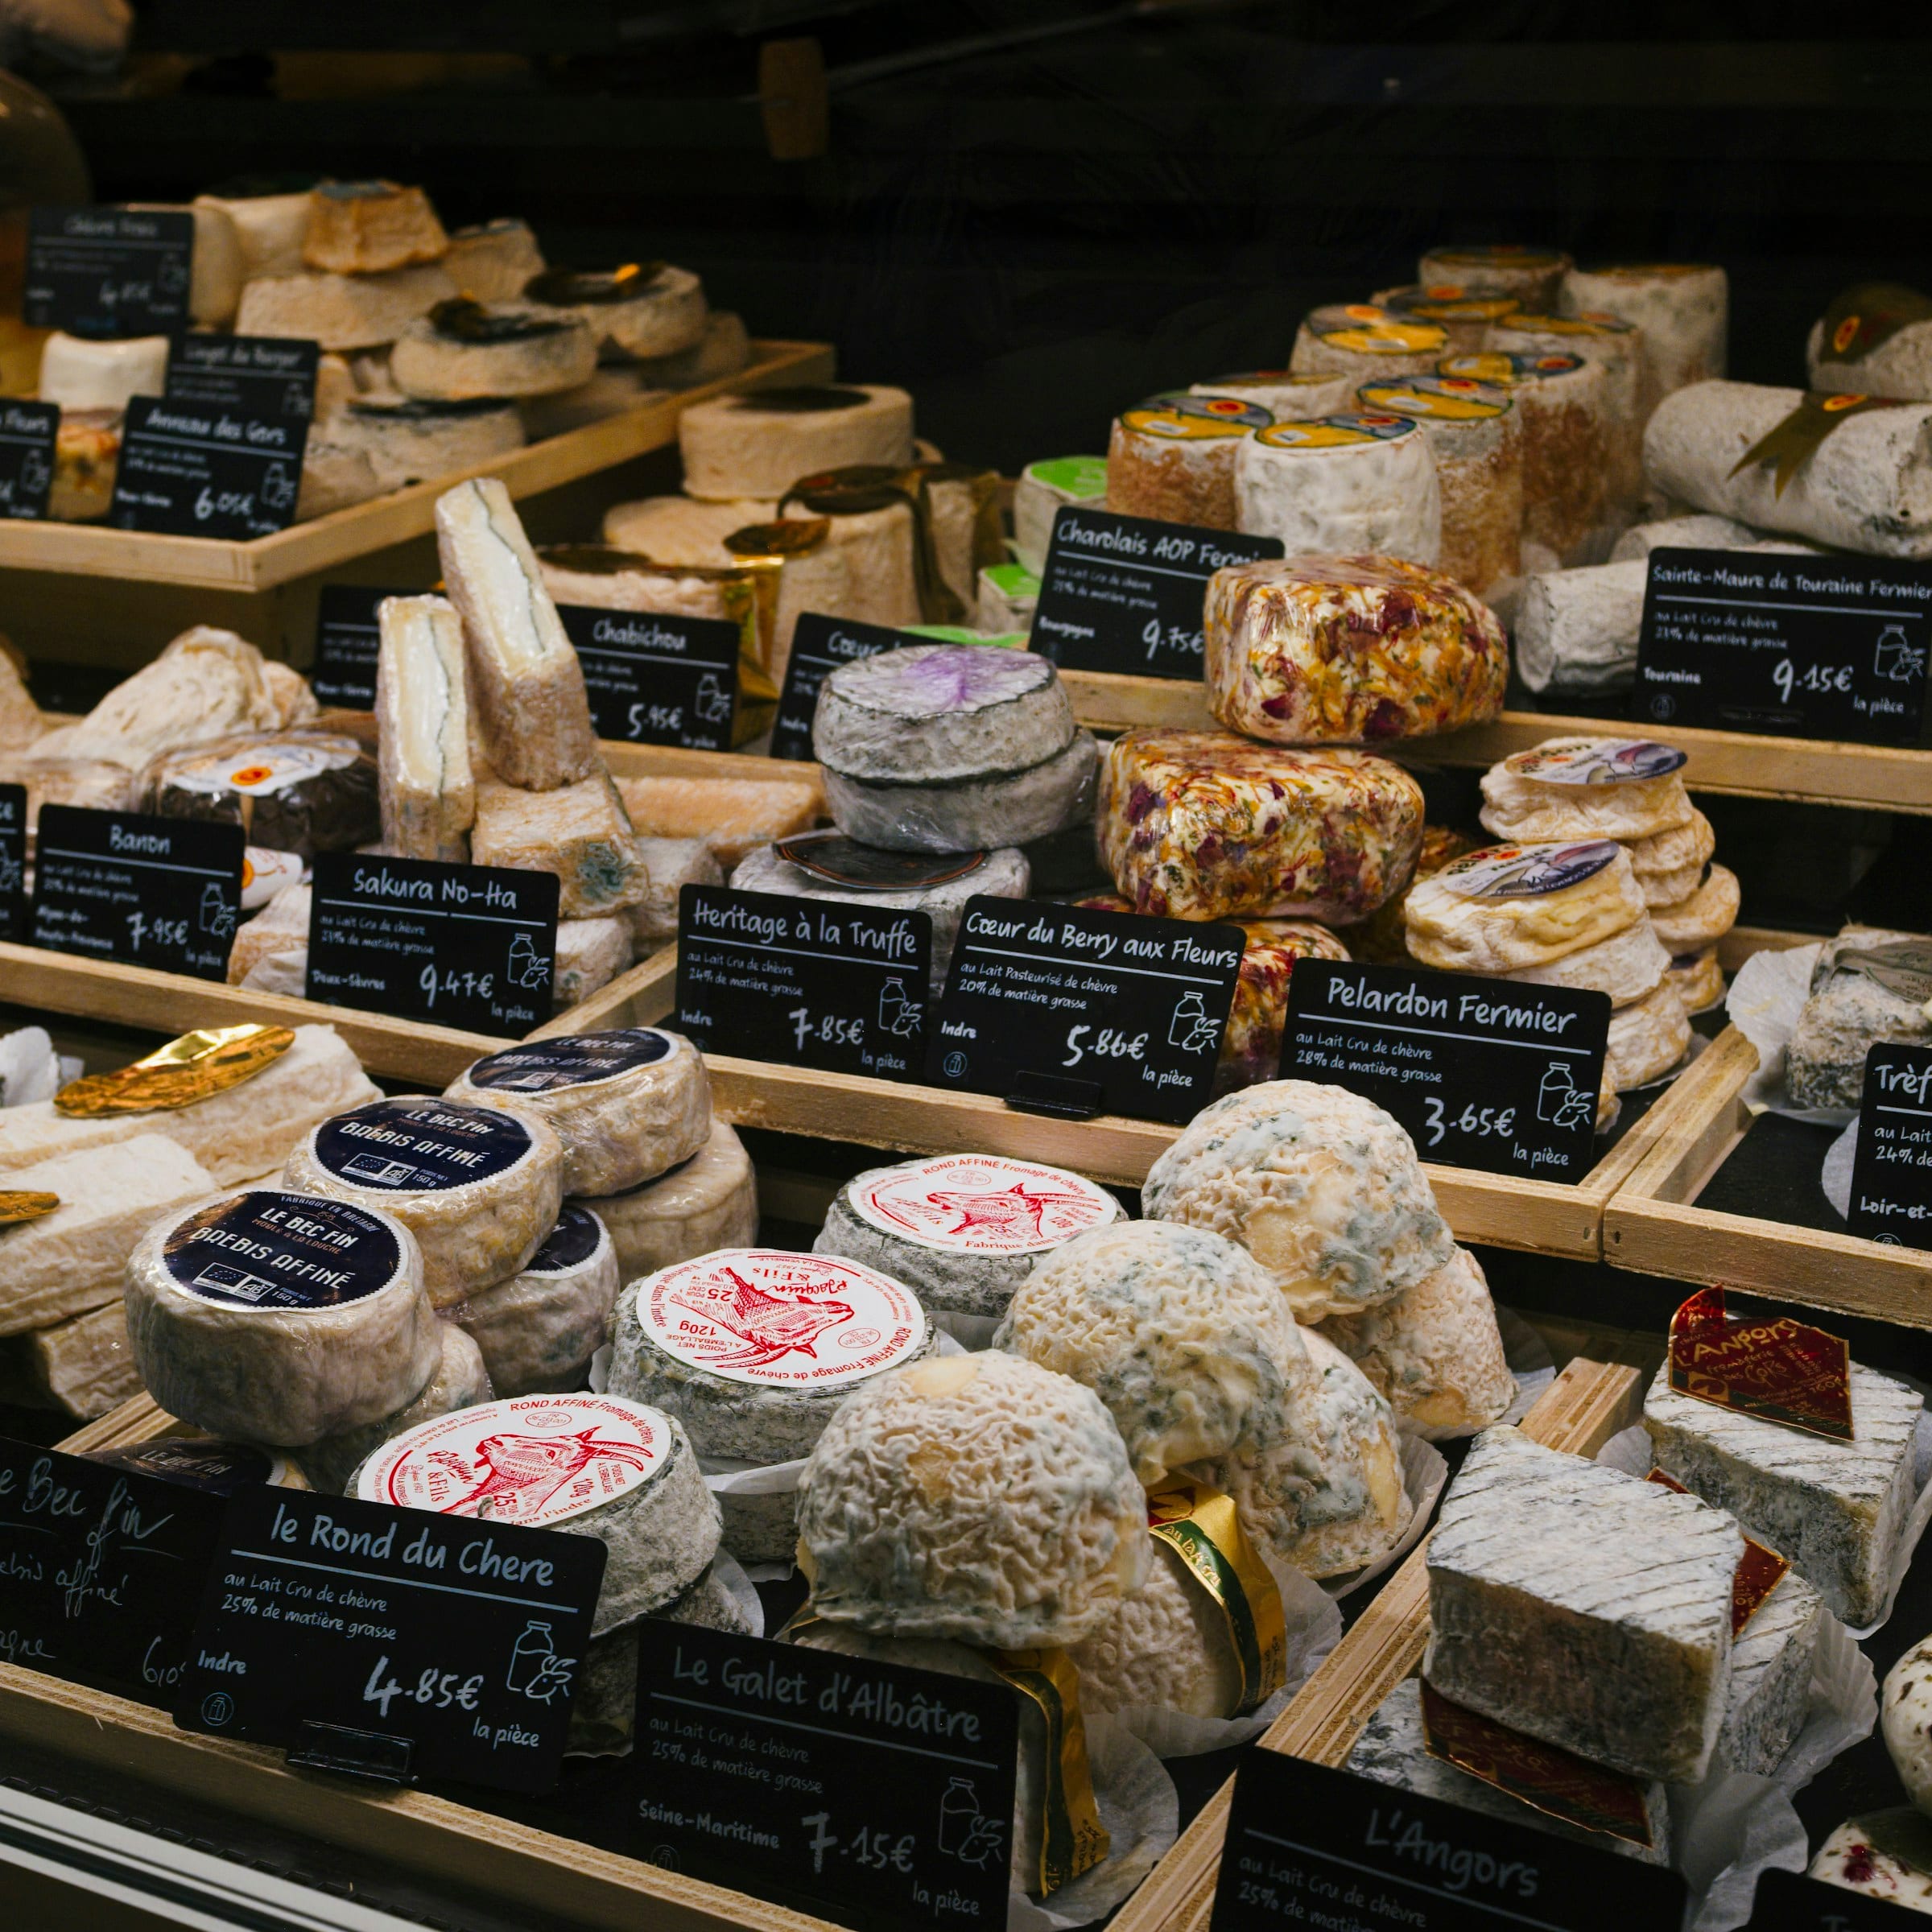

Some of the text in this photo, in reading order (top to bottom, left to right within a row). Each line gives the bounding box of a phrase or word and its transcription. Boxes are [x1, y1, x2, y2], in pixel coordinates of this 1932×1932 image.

[1056, 518, 1260, 568] Charolais AOP Fermi
[1653, 564, 1932, 601] Sainte-Maure de Touraine Fermier
[592, 617, 687, 650] Chabichou
[1644, 666, 1702, 685] Touraine
[1773, 658, 1853, 704] 9.15€
[1853, 695, 1905, 718] la pièce
[109, 824, 171, 854] Banon
[353, 867, 518, 910] Sakura No-Ha
[126, 910, 189, 952] 7.95€
[693, 898, 918, 959] Heritage à la Truffe
[966, 911, 1240, 969] Cœur du Berry aux Fleurs
[687, 952, 794, 976] au Lait Cru de chèvre
[960, 963, 1119, 994] au Lait Pasteurisé de chèvre
[419, 964, 494, 1009] 9.47€
[715, 974, 727, 986] de
[729, 977, 769, 993] matière
[771, 983, 803, 997] grasse
[960, 978, 1088, 1009] 20% de matière grasse
[491, 1002, 535, 1023] la pièce
[681, 1010, 713, 1026] Indre
[1327, 976, 1578, 1034] Pelardon Fermier
[789, 1007, 864, 1051] 7.85€
[941, 1021, 976, 1039] Indre
[1061, 1024, 1150, 1067] 5.86€
[1295, 1033, 1433, 1061] au Lait Cru de chèvre
[861, 1049, 906, 1073] la pièce
[1141, 1065, 1193, 1090] la pièce
[1296, 1050, 1443, 1084] 28% de matière grasse
[338, 1121, 416, 1148] BREBIS
[404, 1109, 494, 1135] LE BEC FIN
[1423, 1096, 1516, 1147] 3.65€
[1874, 1127, 1932, 1143] au Lait
[1513, 1142, 1570, 1169] la pièce
[1875, 1146, 1913, 1164] 24%
[259, 1208, 288, 1223] LE
[285, 1215, 324, 1237] BEC
[322, 1228, 359, 1249] FIN
[192, 1227, 273, 1261] BREBIS
[270, 1254, 356, 1289] AFFINÉ
[751, 1267, 793, 1281] Fils
[708, 1288, 733, 1302] 25
[678, 1320, 717, 1336] 120g
[746, 1326, 913, 1381] ROND AFFINÉ Fromage de chèvre
[510, 1400, 550, 1411] ROND
[551, 1399, 601, 1409] AFFINÉ
[598, 1402, 637, 1422] Fromage
[632, 1419, 646, 1428] de
[23, 1457, 86, 1516] Bec
[270, 1502, 555, 1587] le Rond du Chere
[225, 1571, 387, 1612] au Lait Cru de chèvre
[221, 1594, 397, 1641] 25% de matière grasse
[198, 1650, 247, 1676] Indre
[363, 1654, 485, 1718] 4.85€
[673, 1646, 982, 1743] Le Galet d'Albâtre
[473, 1715, 540, 1750] la pièce
[650, 1716, 810, 1763] au Lait Cru de chèvre
[652, 1740, 825, 1795] 25% de matière grasse
[639, 1799, 781, 1849] Seine-Maritime
[801, 1811, 918, 1874] 7.15€
[1365, 1806, 1542, 1899] L'Angors
[912, 1880, 980, 1918] la pièce
[1237, 1880, 1306, 1919] 25% de
[1239, 1856, 1428, 1928] au Lait Cru de chèvre
